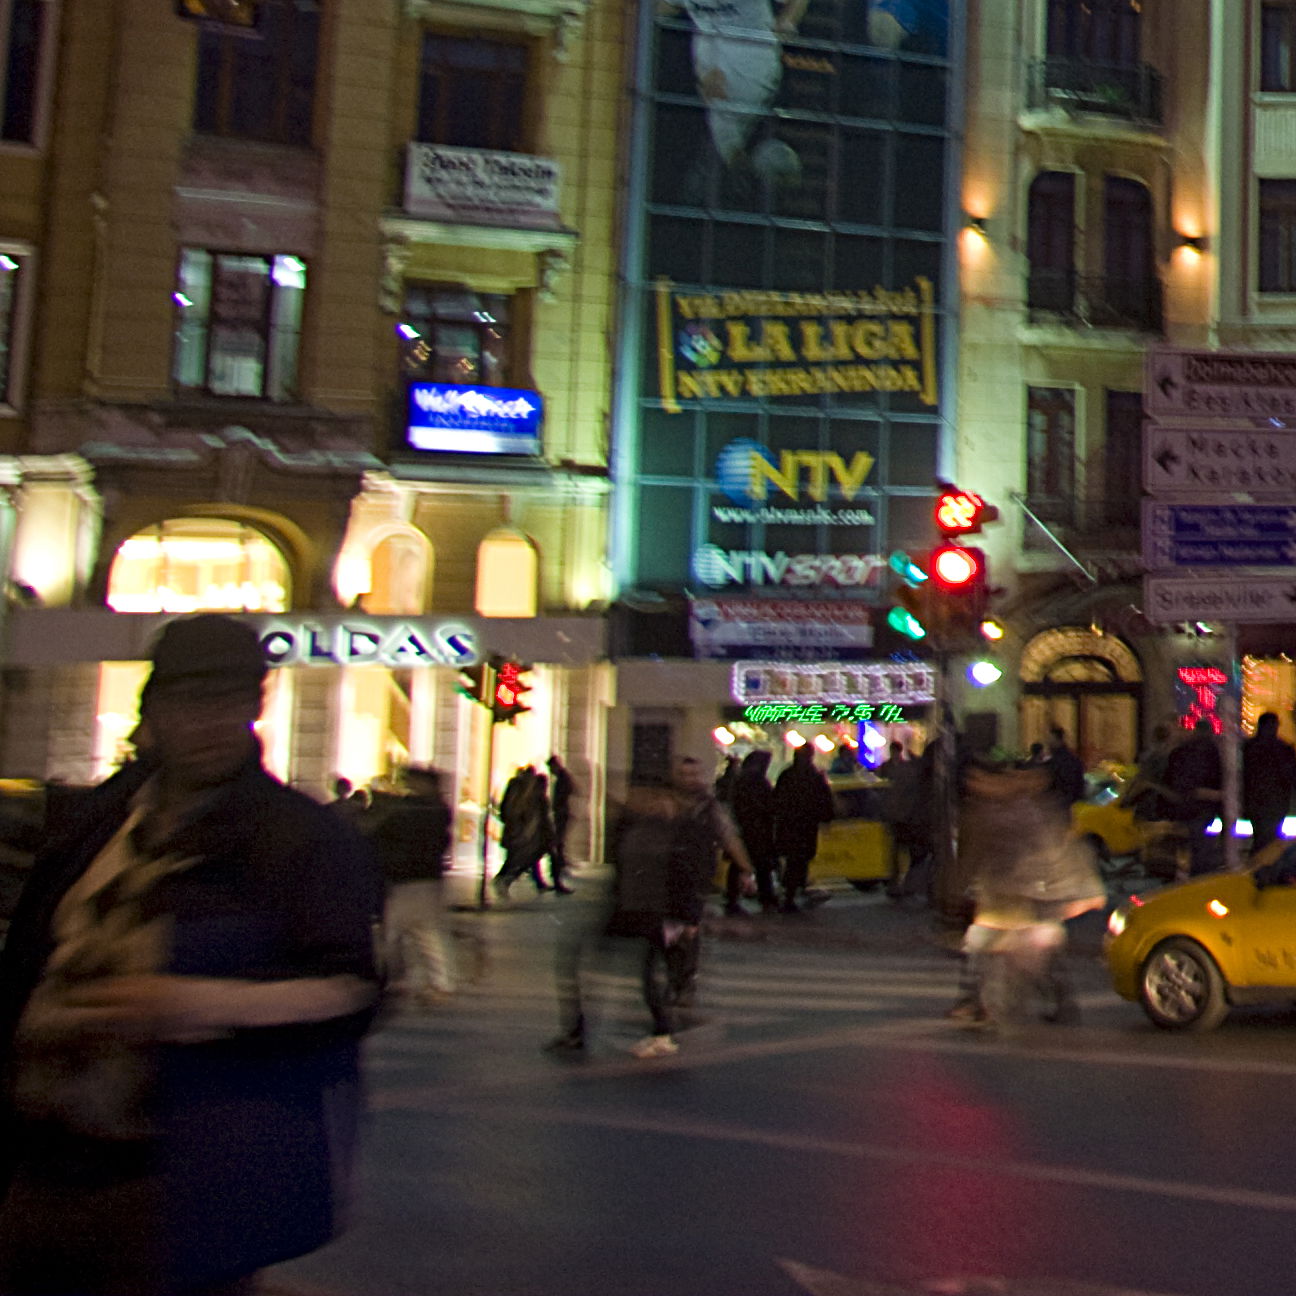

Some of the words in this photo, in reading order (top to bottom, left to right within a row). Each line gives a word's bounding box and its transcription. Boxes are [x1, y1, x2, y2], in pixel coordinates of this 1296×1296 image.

[726, 319, 797, 362] LA
[801, 319, 920, 361] LIGA
[677, 369, 742, 399] NTV
[745, 365, 922, 397] EKRANINDA
[748, 448, 875, 501] NTV
